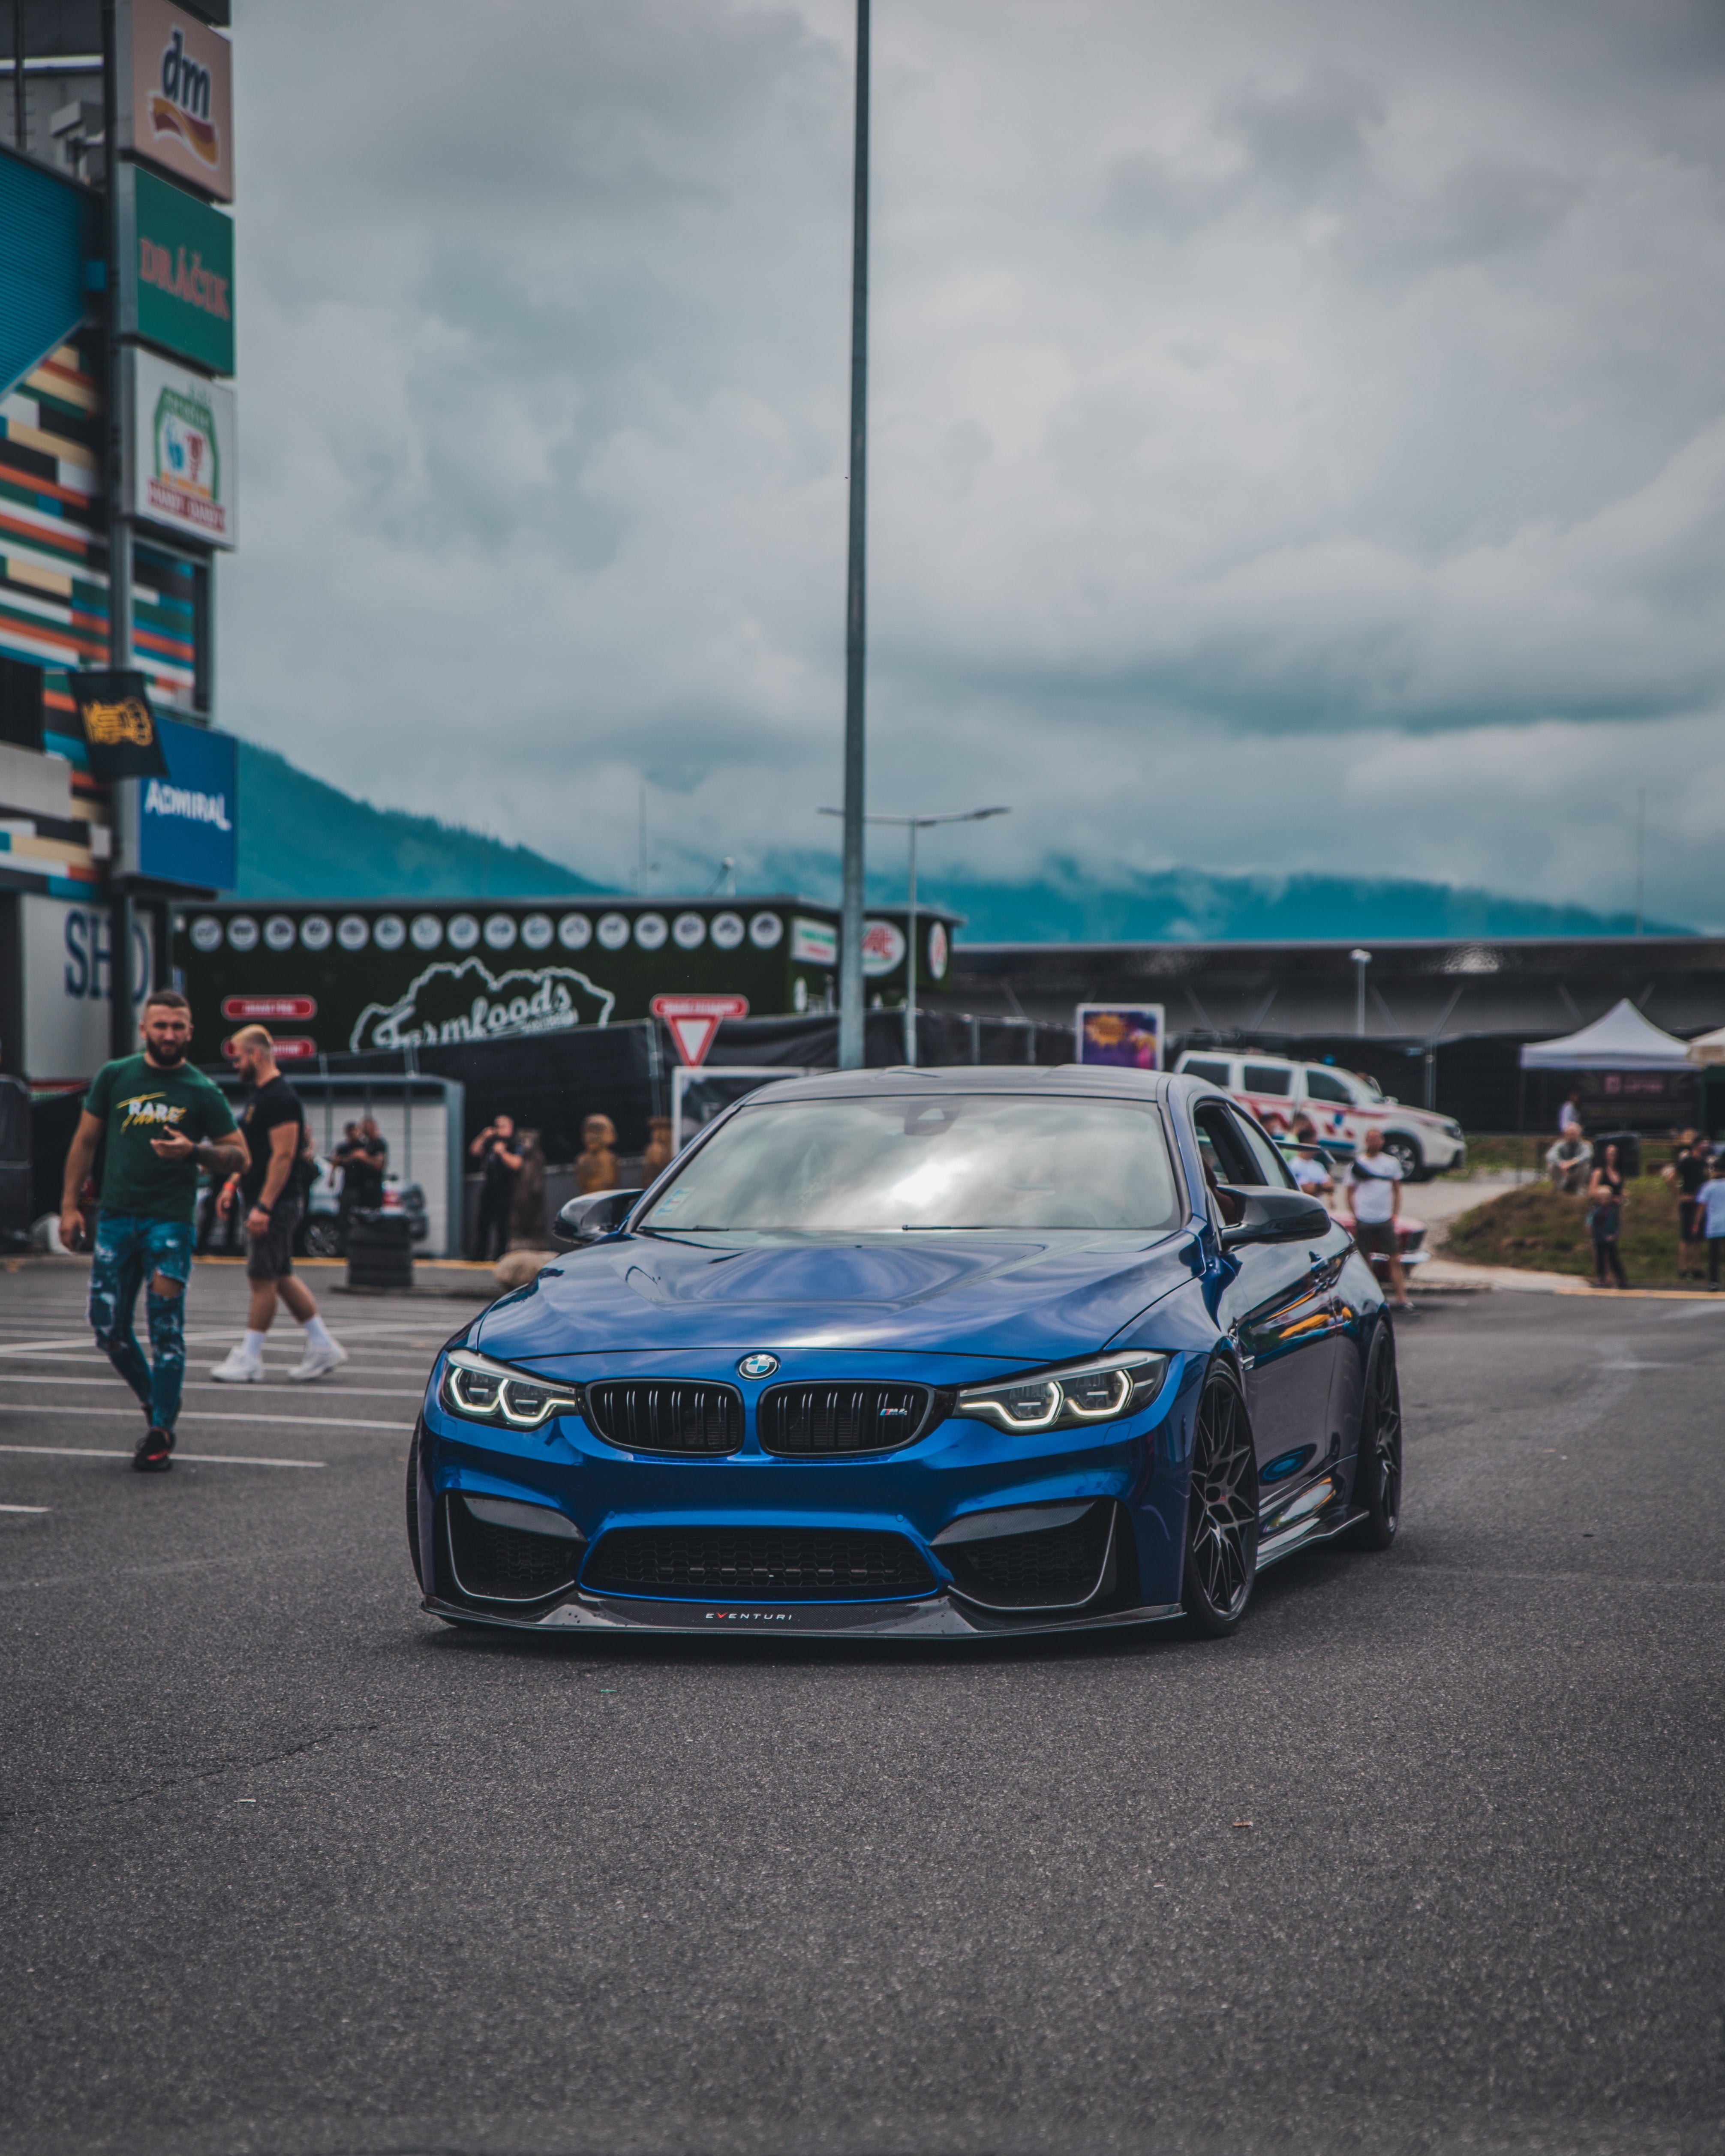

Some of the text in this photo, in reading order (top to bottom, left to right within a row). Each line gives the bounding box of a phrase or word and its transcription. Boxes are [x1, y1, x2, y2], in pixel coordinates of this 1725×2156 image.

[161, 27, 211, 121] dm
[144, 778, 232, 831] ADMIRAL
[705, 1612, 792, 1620] EVENTURI
